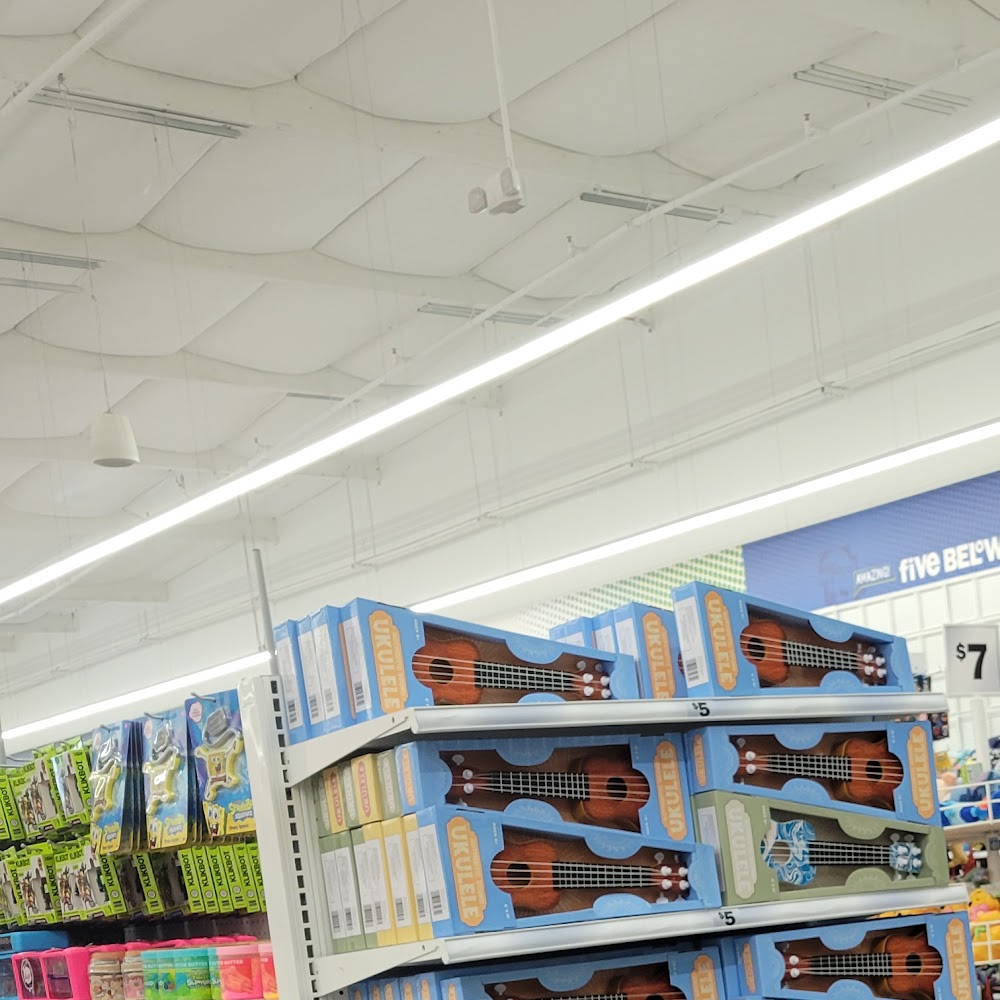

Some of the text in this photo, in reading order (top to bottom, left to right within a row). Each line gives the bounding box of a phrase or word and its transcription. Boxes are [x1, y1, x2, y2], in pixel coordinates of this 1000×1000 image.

[899, 551, 941, 583] five
[372, 617, 400, 710] UKULELE
[645, 619, 669, 698] UKULELE
[707, 598, 734, 683] UKULELE
[956, 643, 988, 680] $7
[692, 702, 710, 717] $5
[661, 746, 684, 834] UKULELE
[910, 731, 932, 812] UKULELE
[450, 824, 481, 919] UKULELE
[728, 806, 752, 894] UKULELE
[718, 911, 736, 926] $5
[949, 924, 972, 1000] UKULELE
